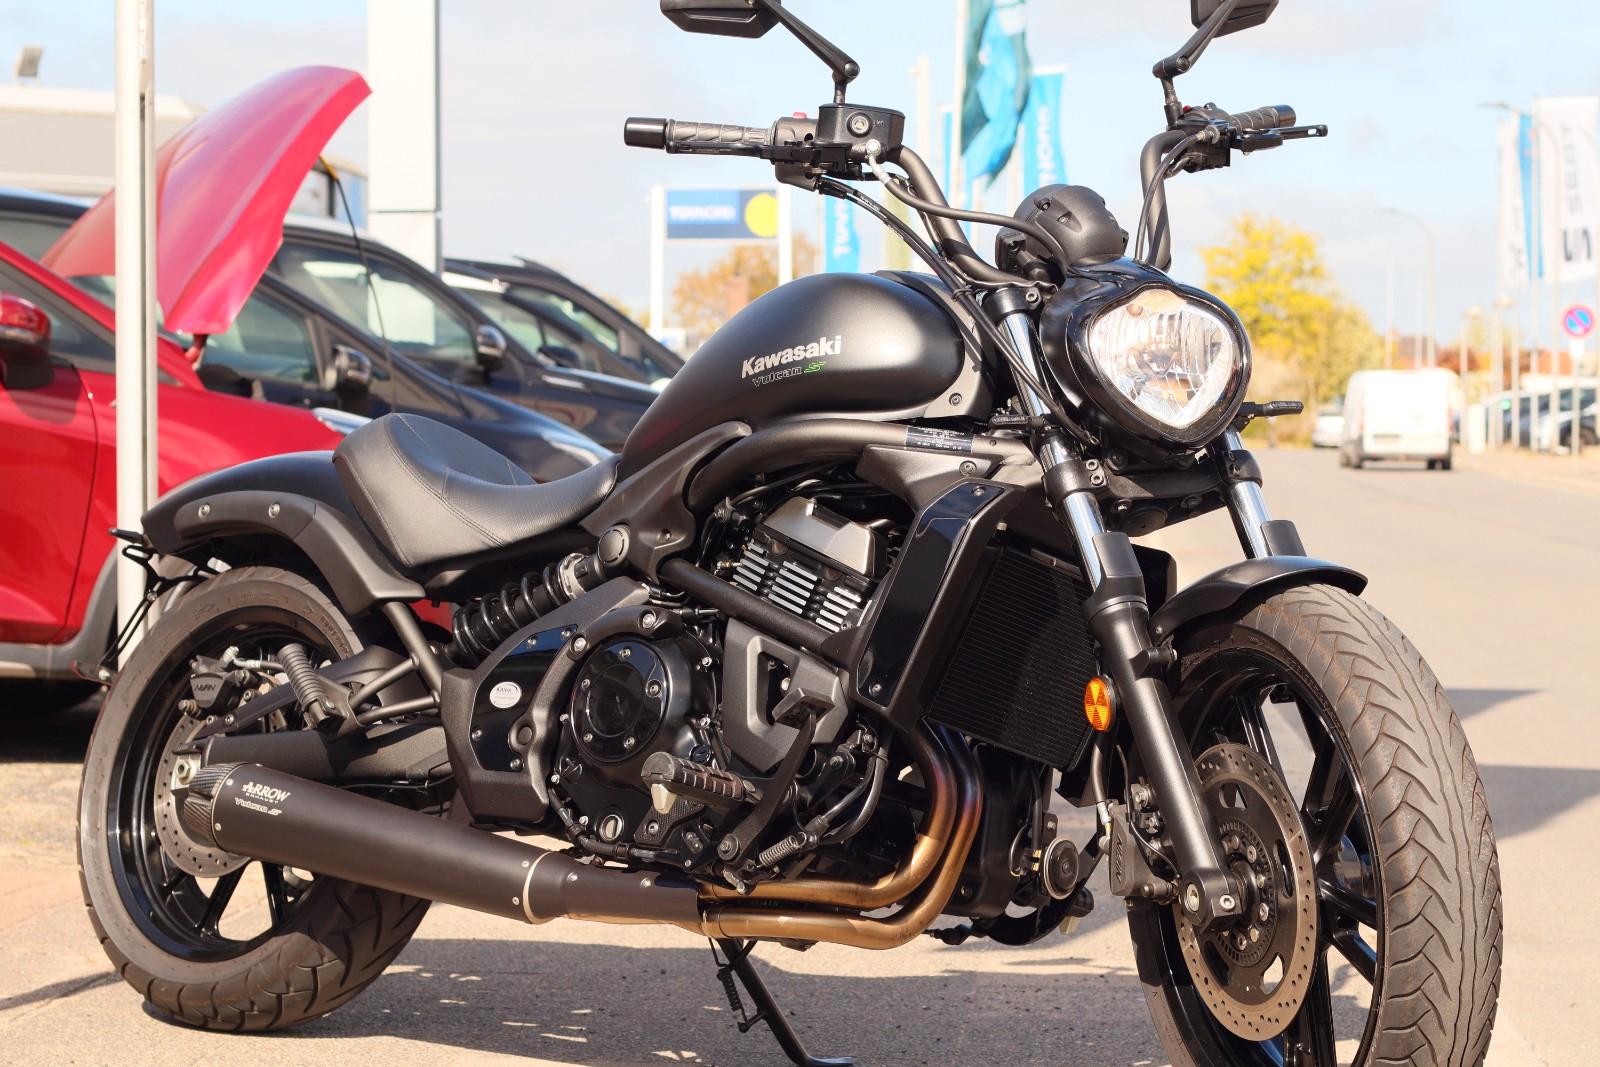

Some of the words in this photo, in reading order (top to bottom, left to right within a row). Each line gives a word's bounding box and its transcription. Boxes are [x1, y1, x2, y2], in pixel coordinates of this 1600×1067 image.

[741, 335, 842, 379] Kawasaki
[803, 361, 826, 374] S
[242, 781, 292, 802] ARROW
